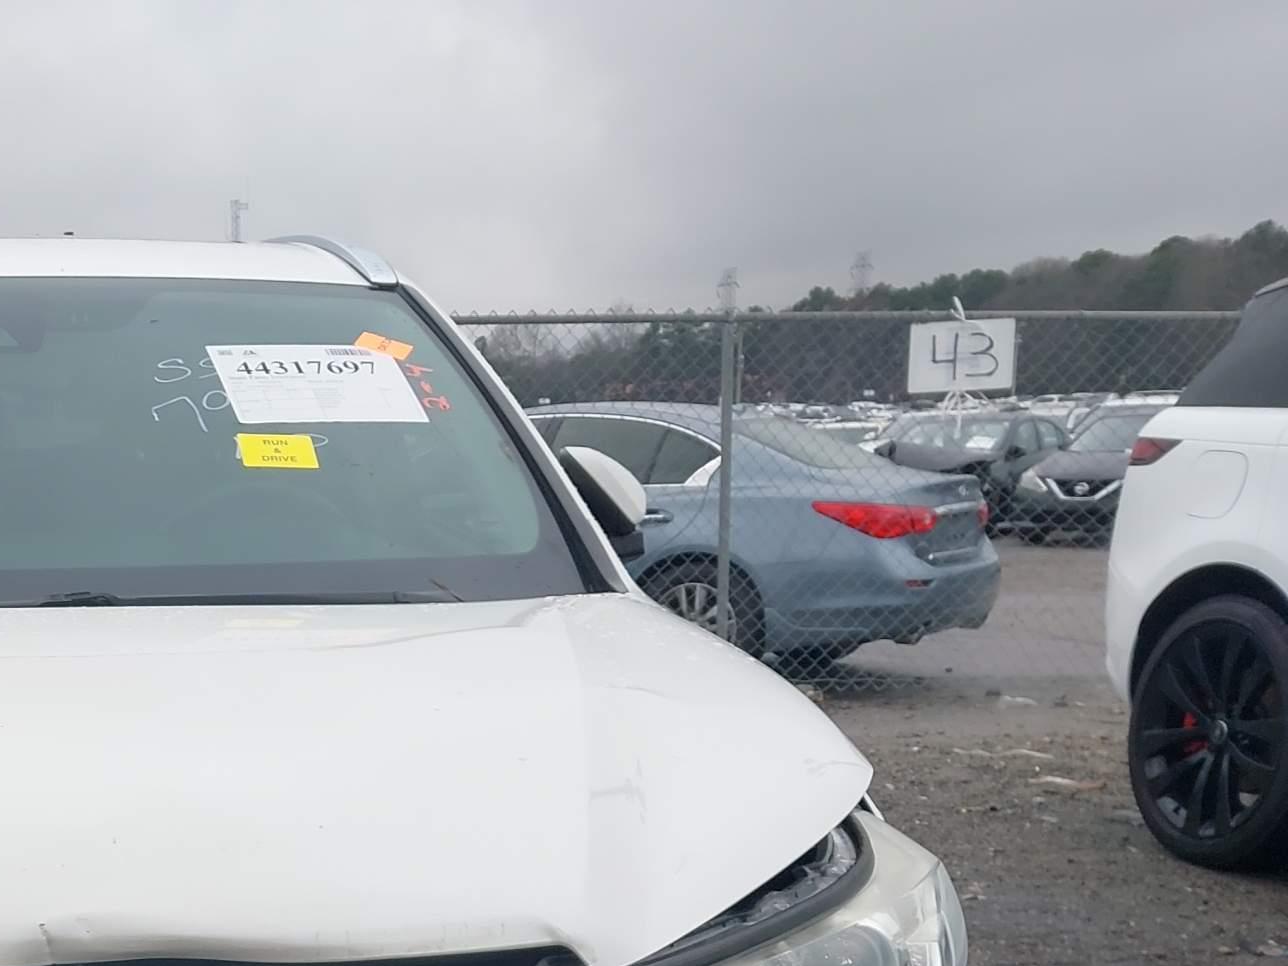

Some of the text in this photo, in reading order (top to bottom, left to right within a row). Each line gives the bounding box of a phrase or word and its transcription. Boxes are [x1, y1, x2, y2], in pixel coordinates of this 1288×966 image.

[931, 332, 999, 381] 43
[236, 361, 375, 375] 44317697
[261, 455, 298, 463] DRIVE
